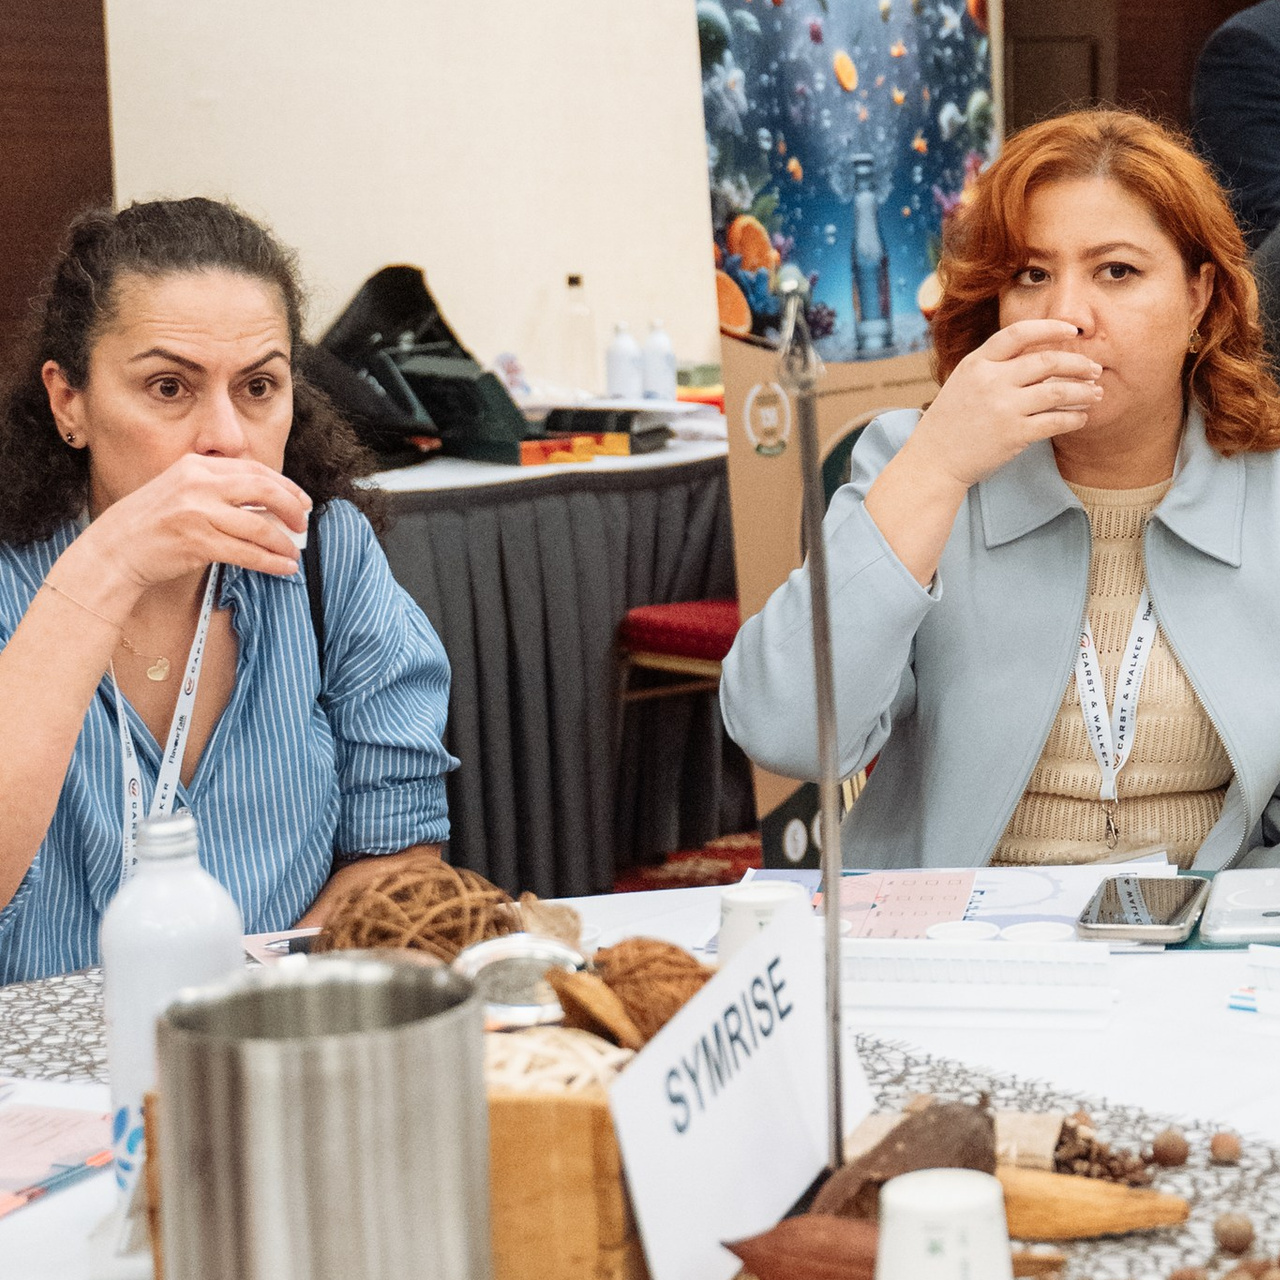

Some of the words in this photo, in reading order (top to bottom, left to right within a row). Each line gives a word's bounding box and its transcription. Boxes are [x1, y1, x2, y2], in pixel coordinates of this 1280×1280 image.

[1081, 652, 1096, 694] CARST
[1125, 636, 1144, 686] WALKER
[1091, 701, 1098, 709] &
[1123, 693, 1130, 701] &
[1093, 714, 1109, 767] WALKER
[1117, 707, 1127, 750] CARST
[664, 956, 794, 1136] SYMRISE
